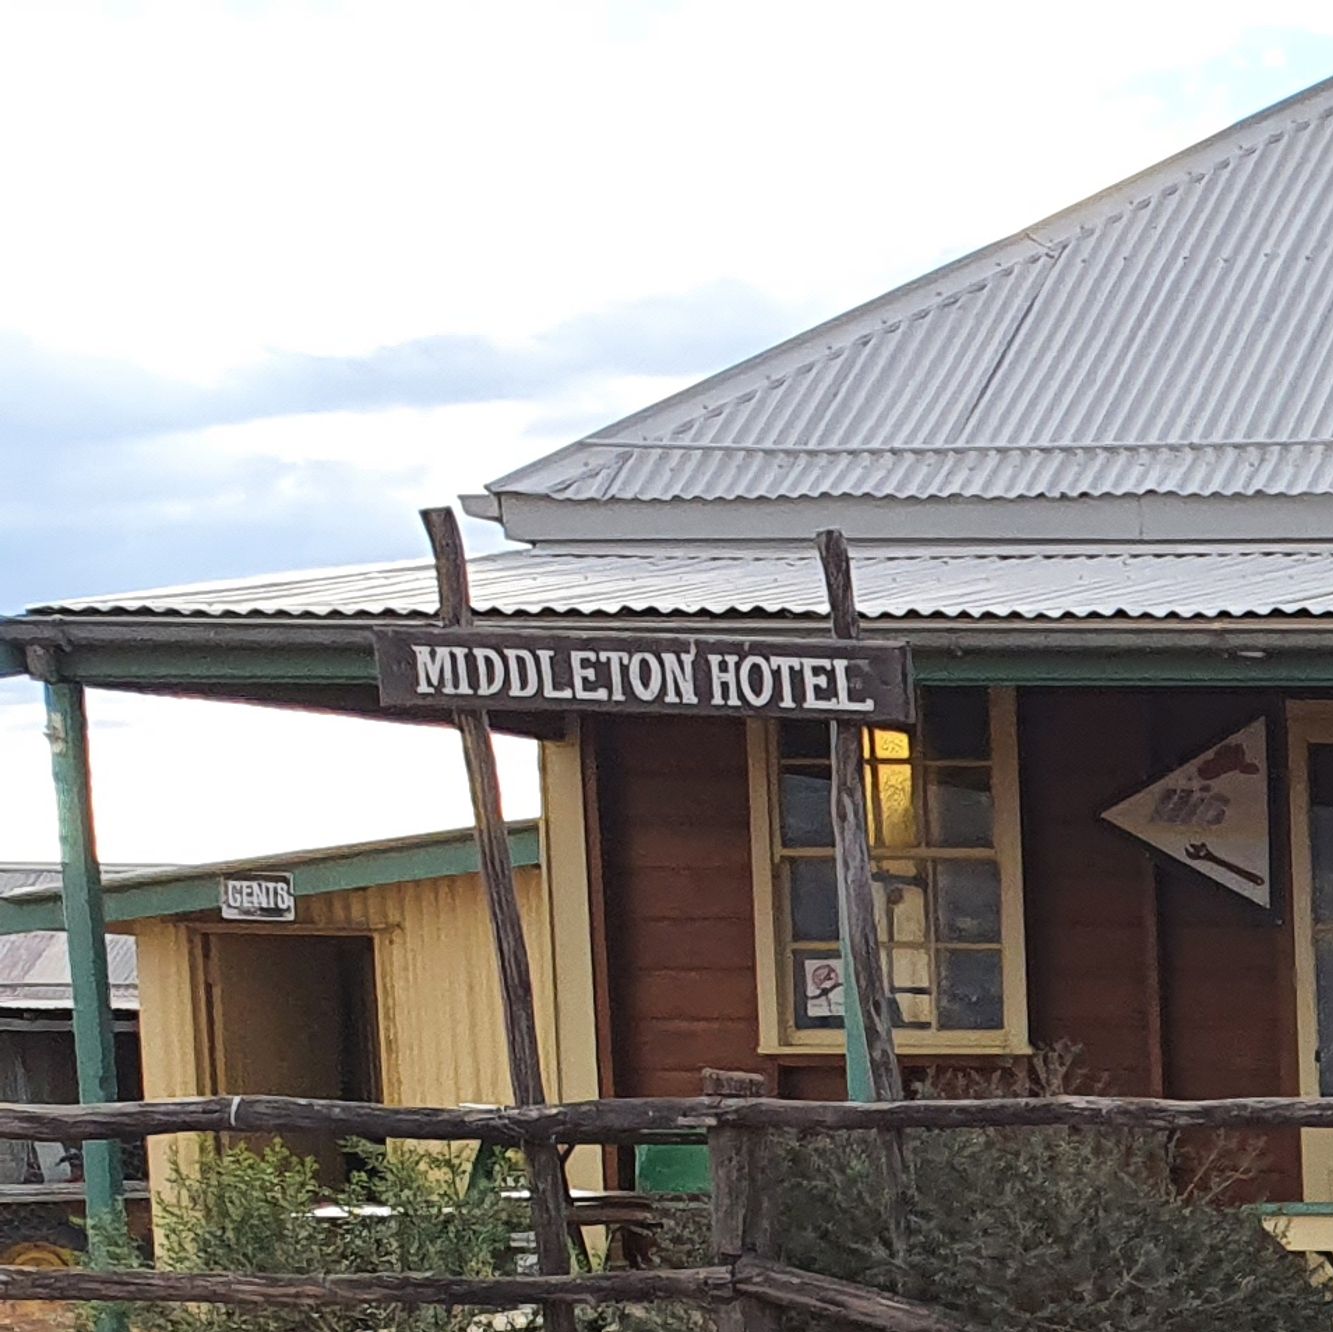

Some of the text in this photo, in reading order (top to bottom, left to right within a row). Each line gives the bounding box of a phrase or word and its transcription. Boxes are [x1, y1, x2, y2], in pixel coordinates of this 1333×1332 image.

[411, 642, 875, 713] MIDDLETON HOTEL
[227, 880, 290, 911] GENTS
